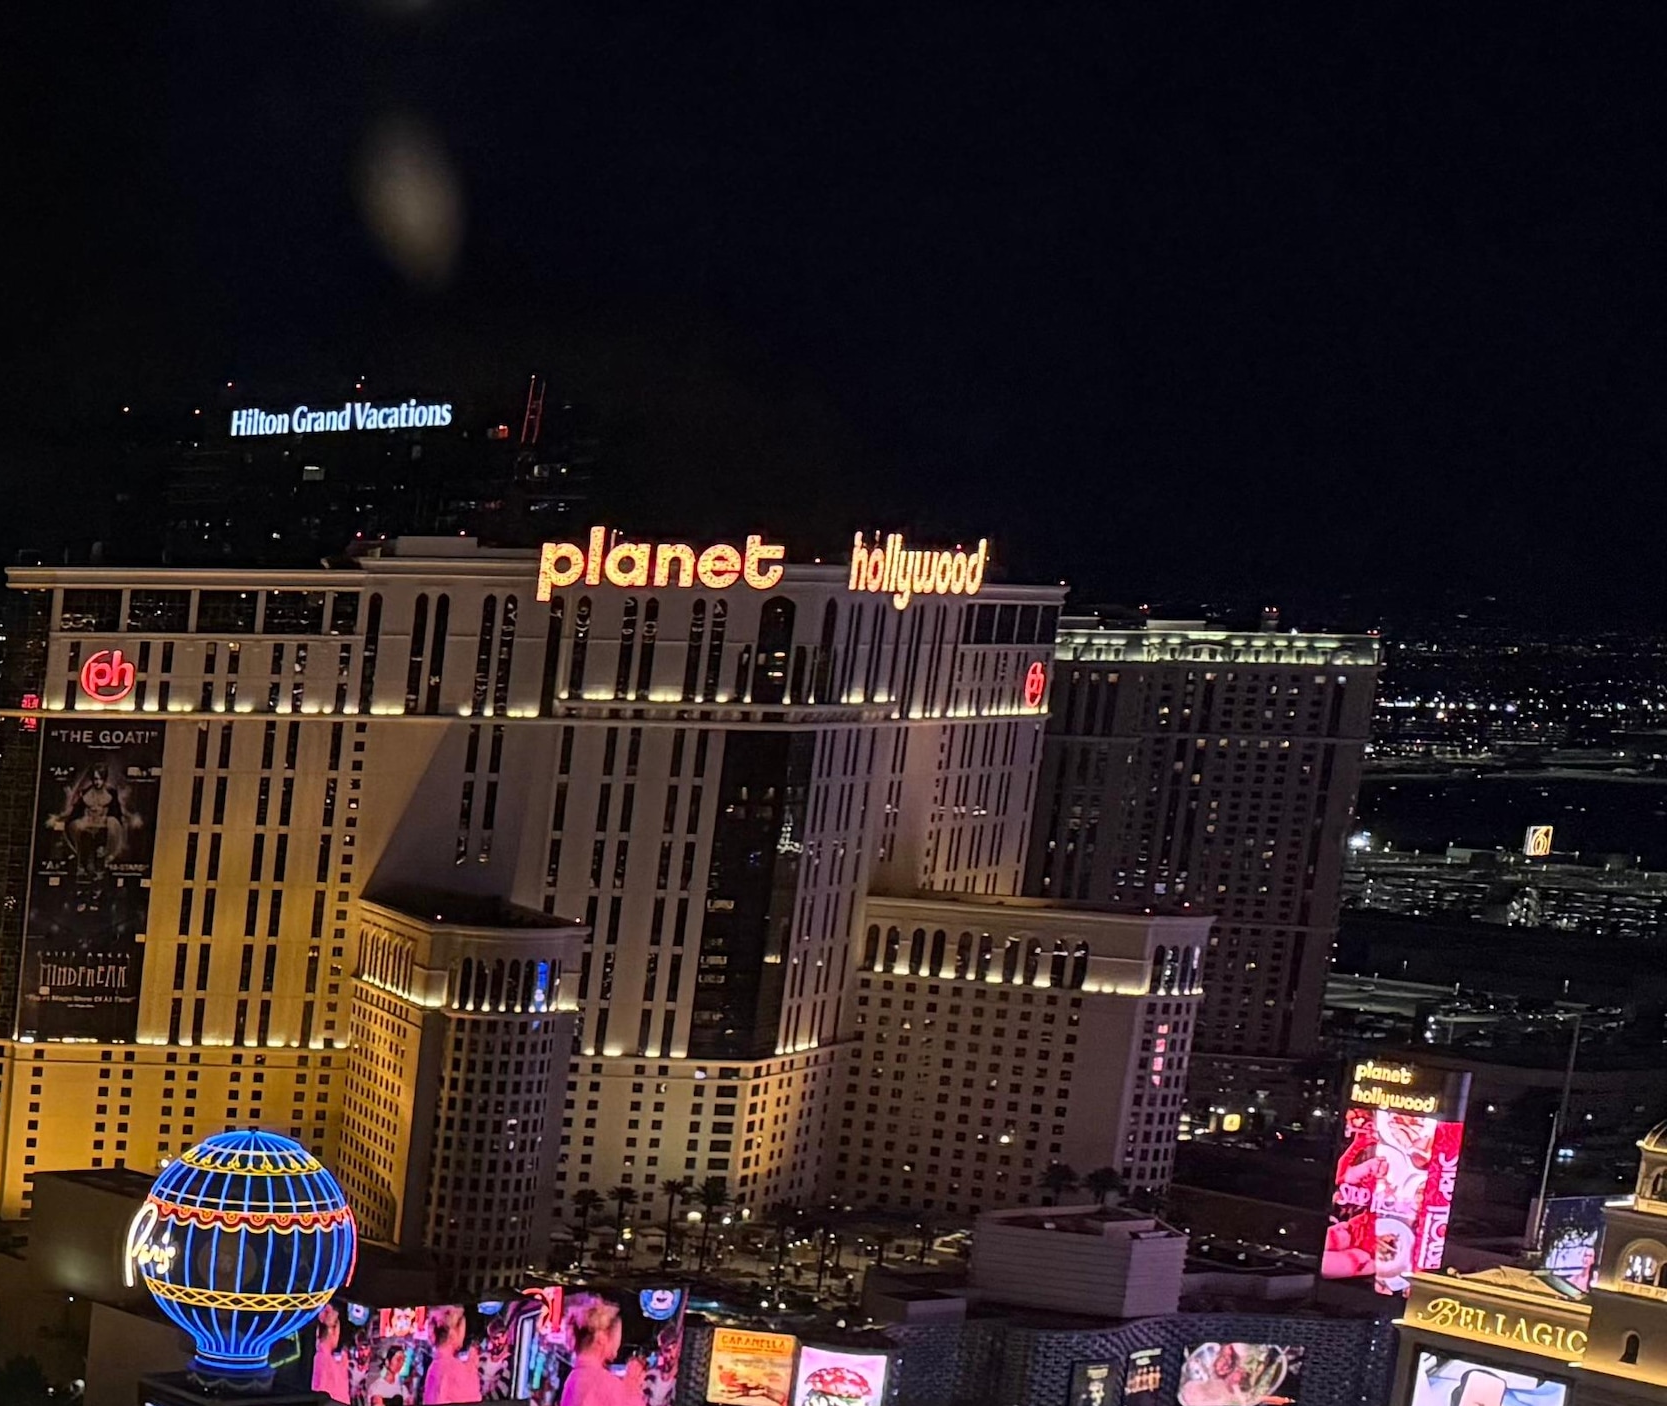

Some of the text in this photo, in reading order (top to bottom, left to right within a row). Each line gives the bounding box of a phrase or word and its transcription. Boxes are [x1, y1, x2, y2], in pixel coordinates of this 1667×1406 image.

[230, 399, 452, 436] Hilton Grand Vacations
[535, 525, 988, 610] planet hollywood
[88, 649, 135, 693] ph
[1354, 1060, 1412, 1085] planet
[1350, 1084, 1437, 1113] hollywood
[721, 1335, 786, 1350] CARAMELLA
